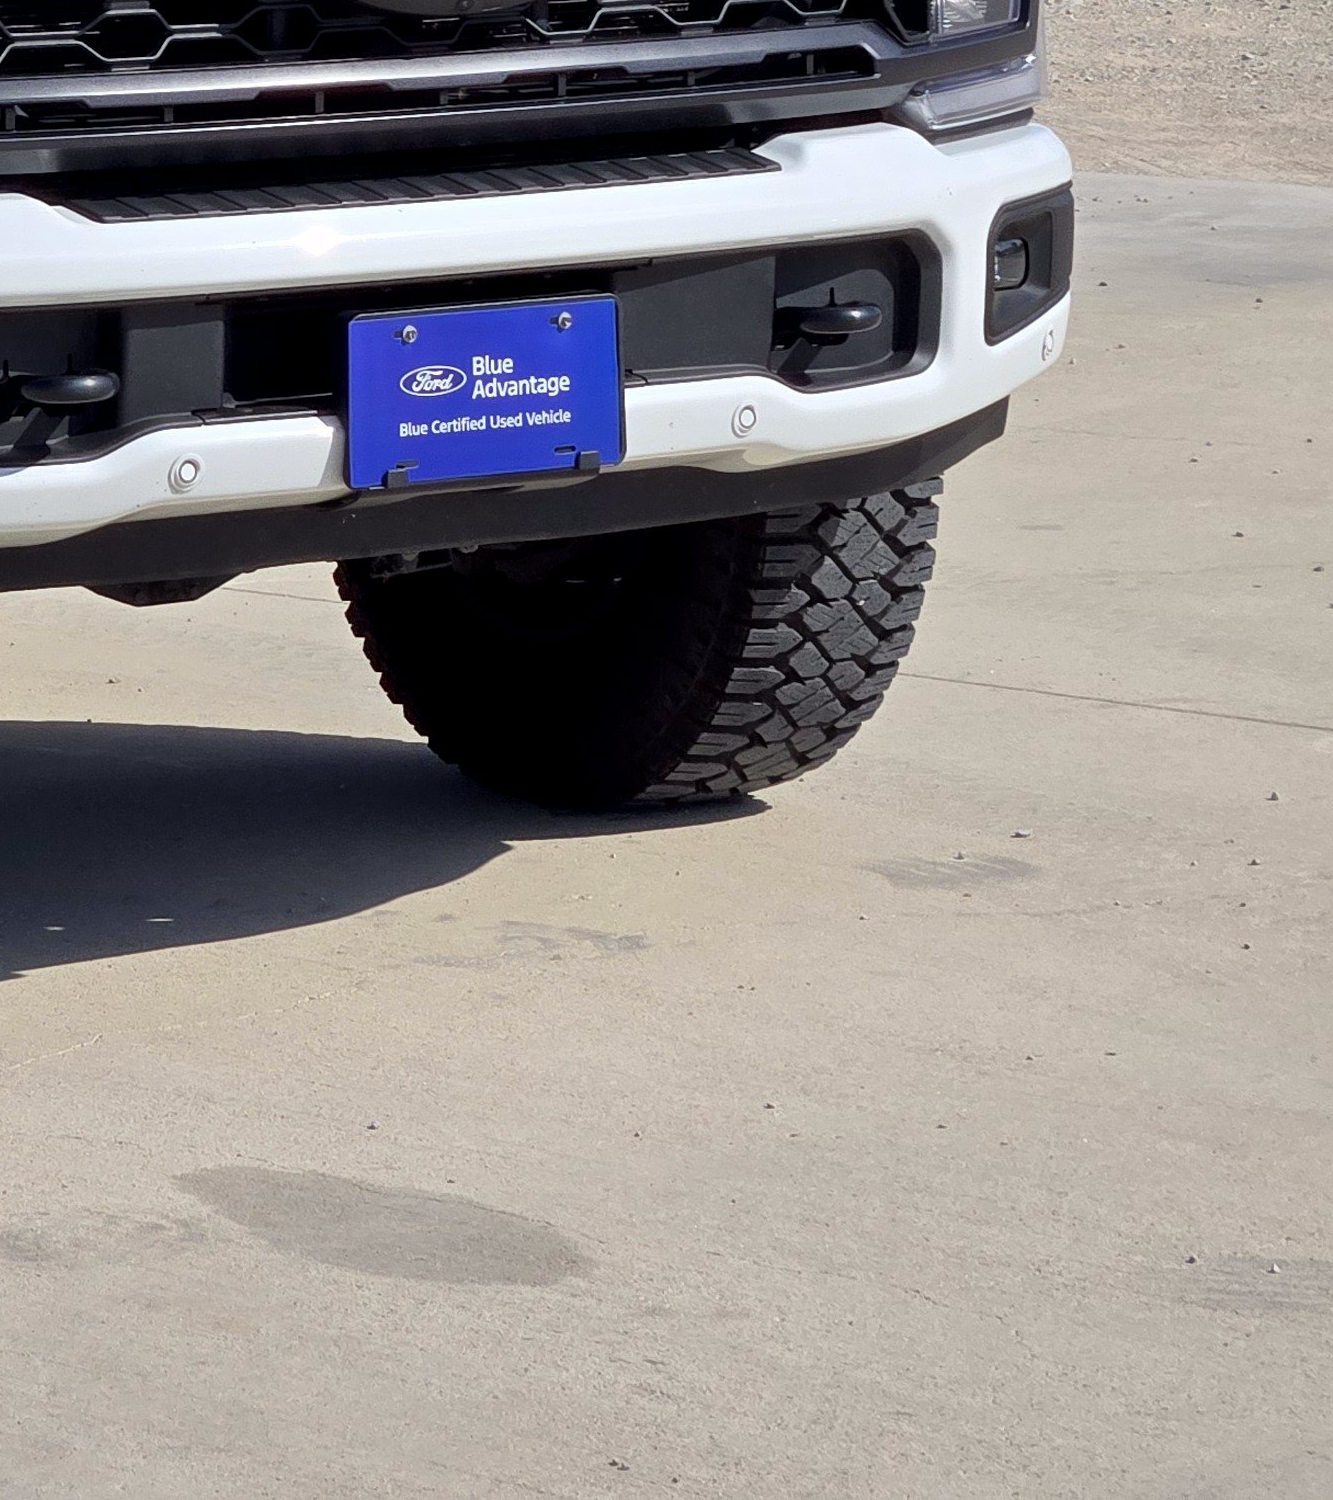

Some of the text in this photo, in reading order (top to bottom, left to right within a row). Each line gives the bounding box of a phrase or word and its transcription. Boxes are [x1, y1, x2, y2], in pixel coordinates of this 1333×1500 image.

[411, 355, 514, 393] Ford Blue
[471, 375, 571, 400] Advantage
[399, 408, 572, 438] Blue Certified Used Vehicle
